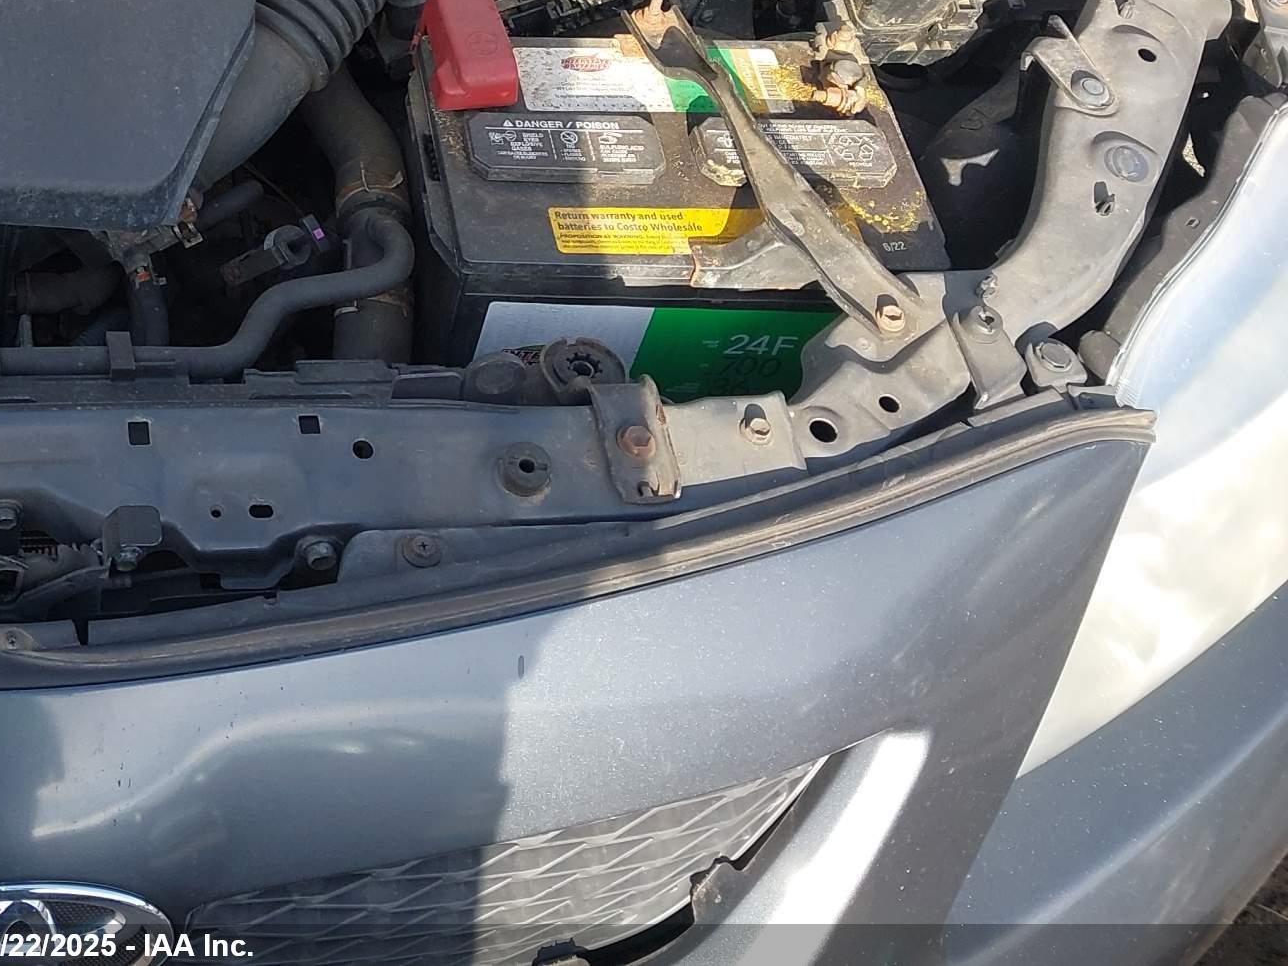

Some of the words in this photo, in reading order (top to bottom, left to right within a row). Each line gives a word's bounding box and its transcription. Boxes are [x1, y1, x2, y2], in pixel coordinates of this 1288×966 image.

[515, 120, 564, 129] DANGER
[575, 121, 620, 130] POISON
[554, 211, 589, 221] Return
[590, 212, 636, 222] warranty
[638, 211, 657, 221] and
[659, 212, 683, 221] used
[558, 223, 602, 231] batteries
[616, 223, 649, 232] Costco
[650, 223, 703, 232] Wholesale
[723, 334, 799, 356] 24F
